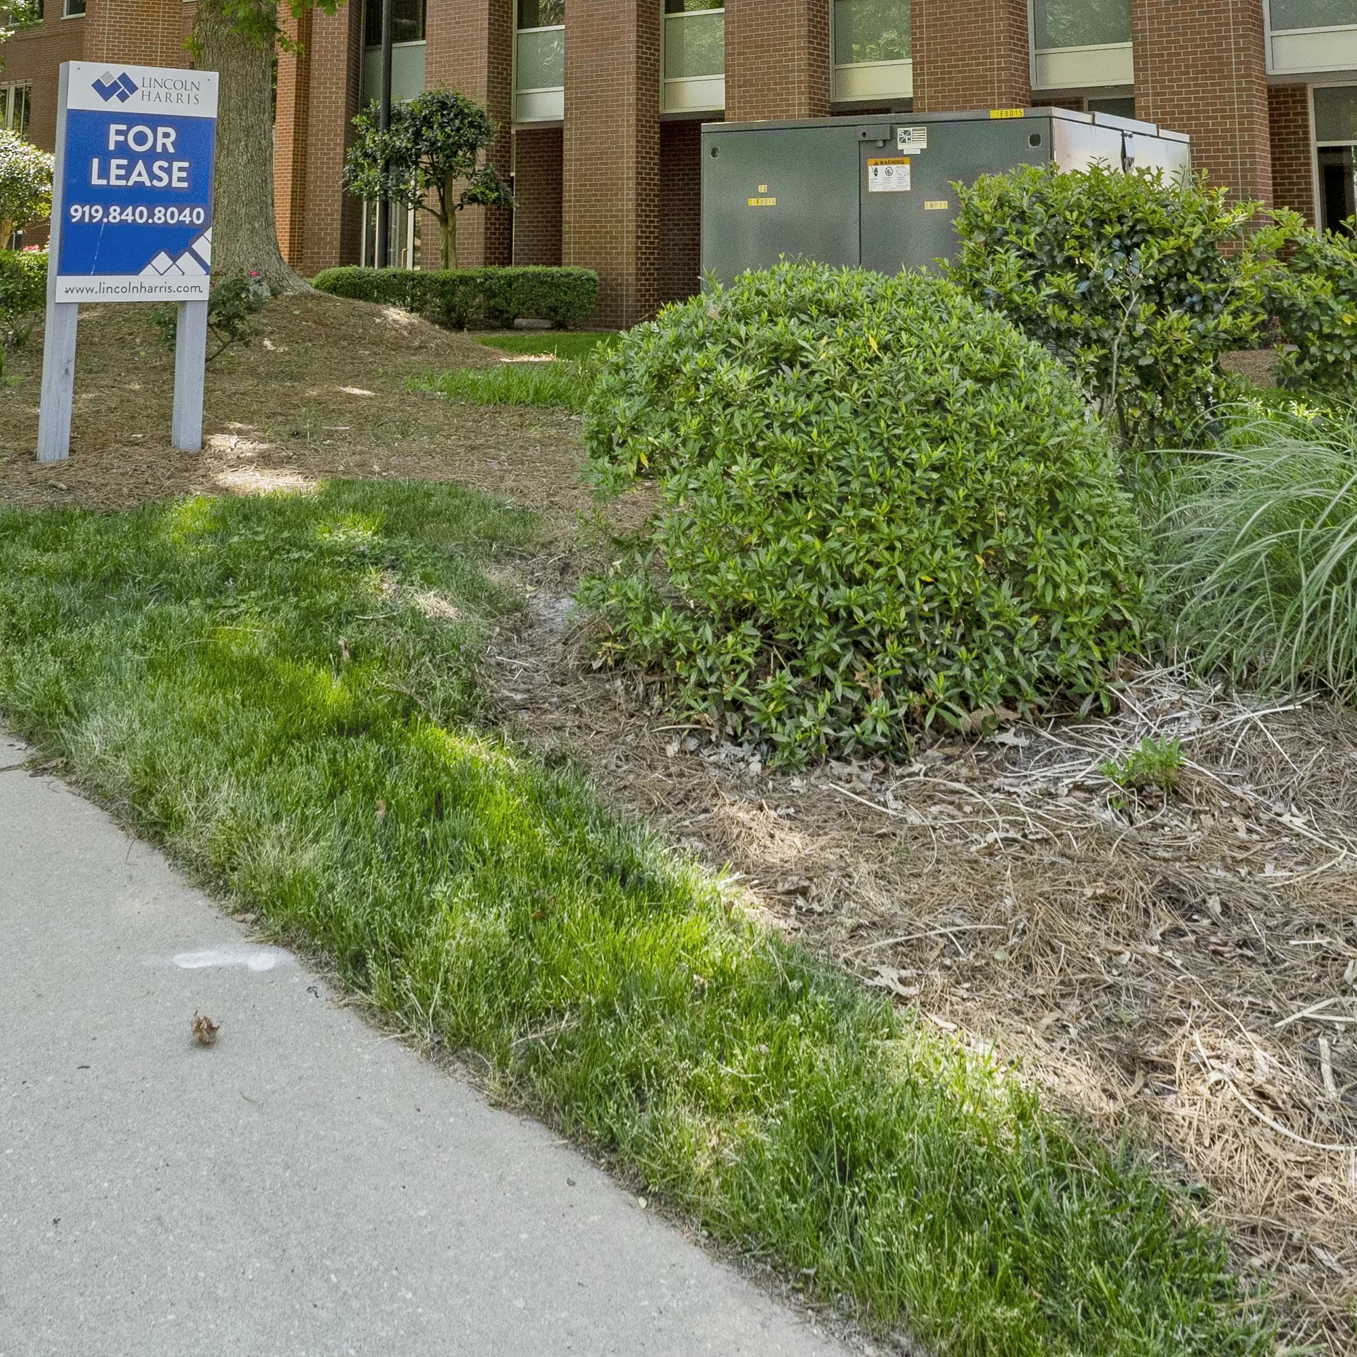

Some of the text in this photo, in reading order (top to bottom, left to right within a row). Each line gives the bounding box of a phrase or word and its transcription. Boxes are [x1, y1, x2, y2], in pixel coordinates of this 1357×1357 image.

[142, 77, 200, 91] LINCOLN
[142, 91, 200, 105] HARRIS
[108, 124, 176, 152] FOR
[91, 158, 189, 188] LEASE
[70, 204, 205, 224] 919.840.8040
[64, 282, 201, 295] www.lincolnharris.com
